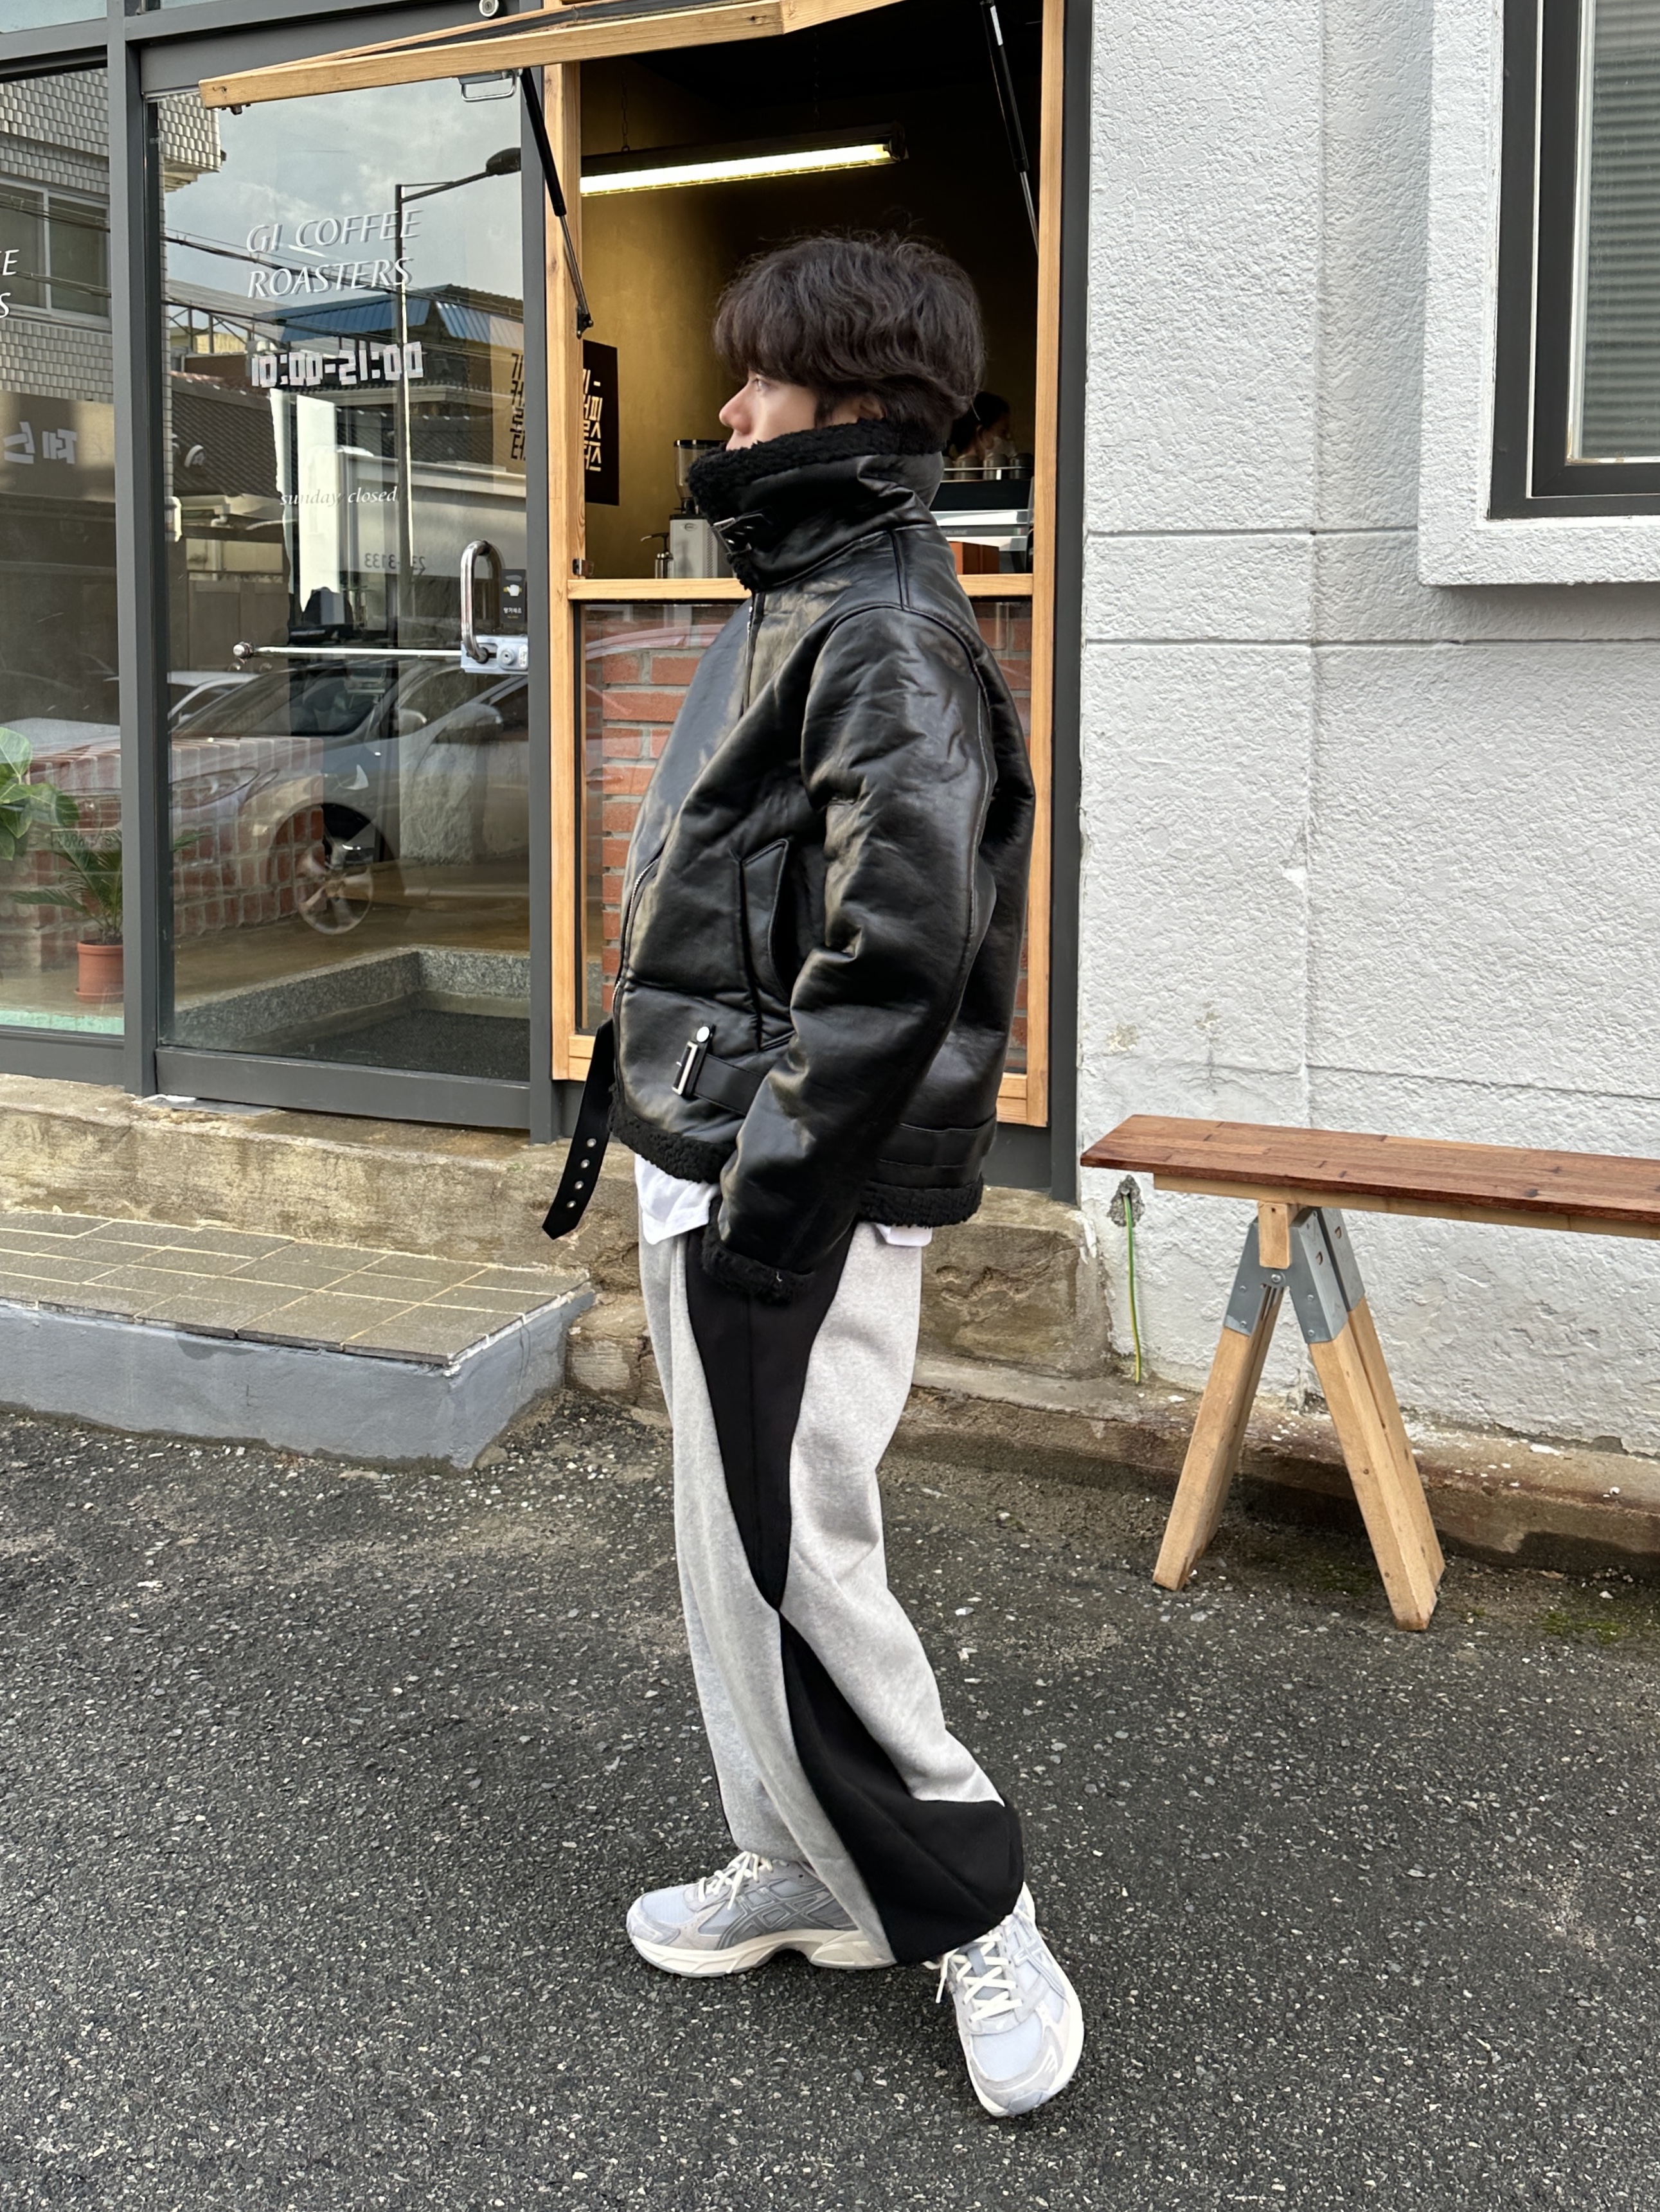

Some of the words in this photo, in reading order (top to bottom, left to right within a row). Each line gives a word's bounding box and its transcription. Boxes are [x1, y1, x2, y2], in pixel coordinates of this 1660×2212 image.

[246, 223, 281, 253] GI
[295, 209, 424, 248] COFFEE
[0, 249, 20, 276] E
[247, 257, 414, 298] ROASTERS
[251, 341, 424, 388] 10:00-21:00
[280, 488, 341, 506] sunday
[348, 486, 398, 503] closed
